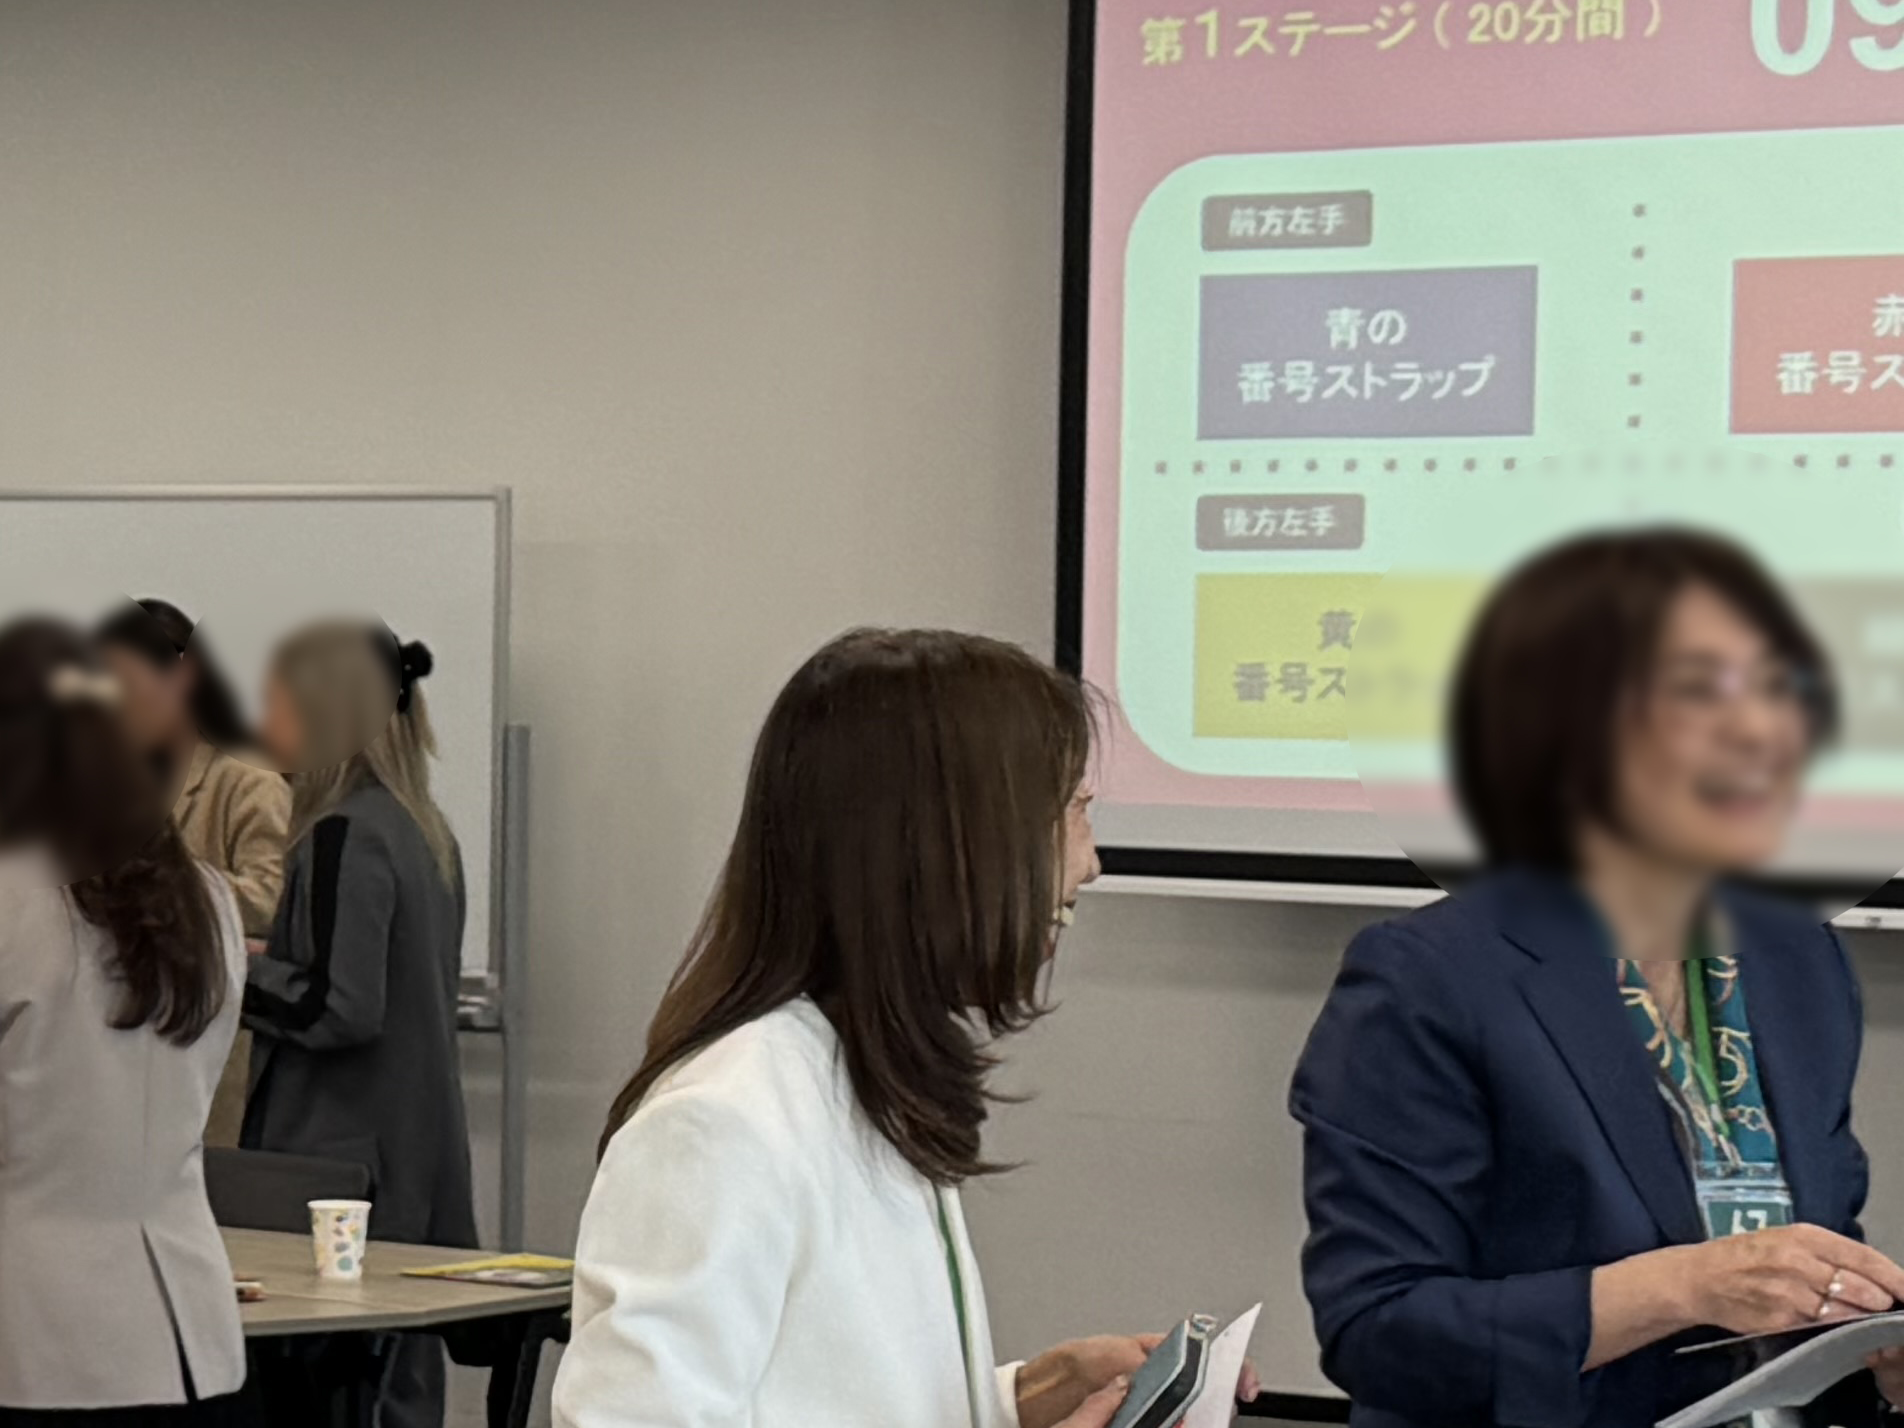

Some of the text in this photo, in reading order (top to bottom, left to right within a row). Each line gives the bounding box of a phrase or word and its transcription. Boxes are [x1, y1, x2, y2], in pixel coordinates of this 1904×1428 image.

[1228, 203, 1345, 237] 前方左手
[1325, 306, 1408, 350] 青の
[1237, 353, 1496, 404] 番号ストラップ
[1223, 505, 1338, 538] 後方左手
